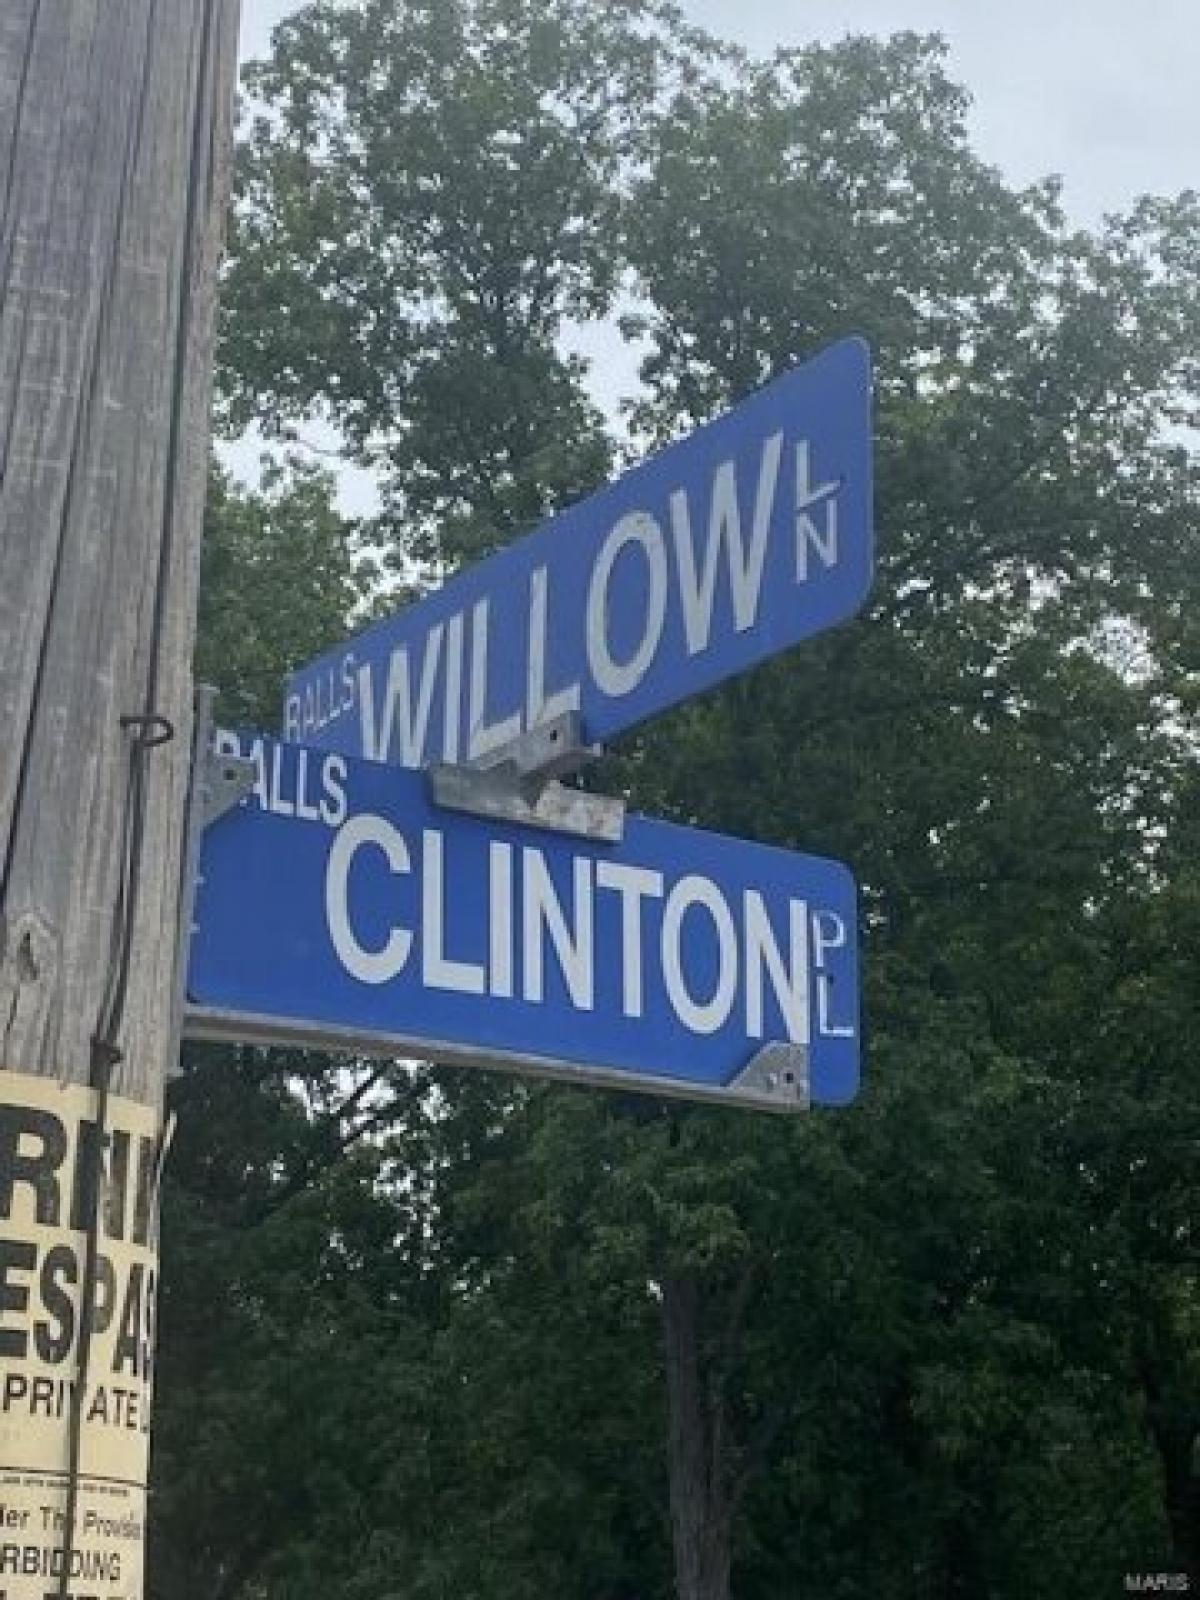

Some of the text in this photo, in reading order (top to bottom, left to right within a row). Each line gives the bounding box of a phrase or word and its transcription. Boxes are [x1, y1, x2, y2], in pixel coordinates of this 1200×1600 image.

[284, 430, 843, 770] RALLS WILLOW LN
[326, 813, 811, 1044] CLINTON
[812, 908, 855, 1038] PL
[0, 1240, 154, 1381] ESPA
